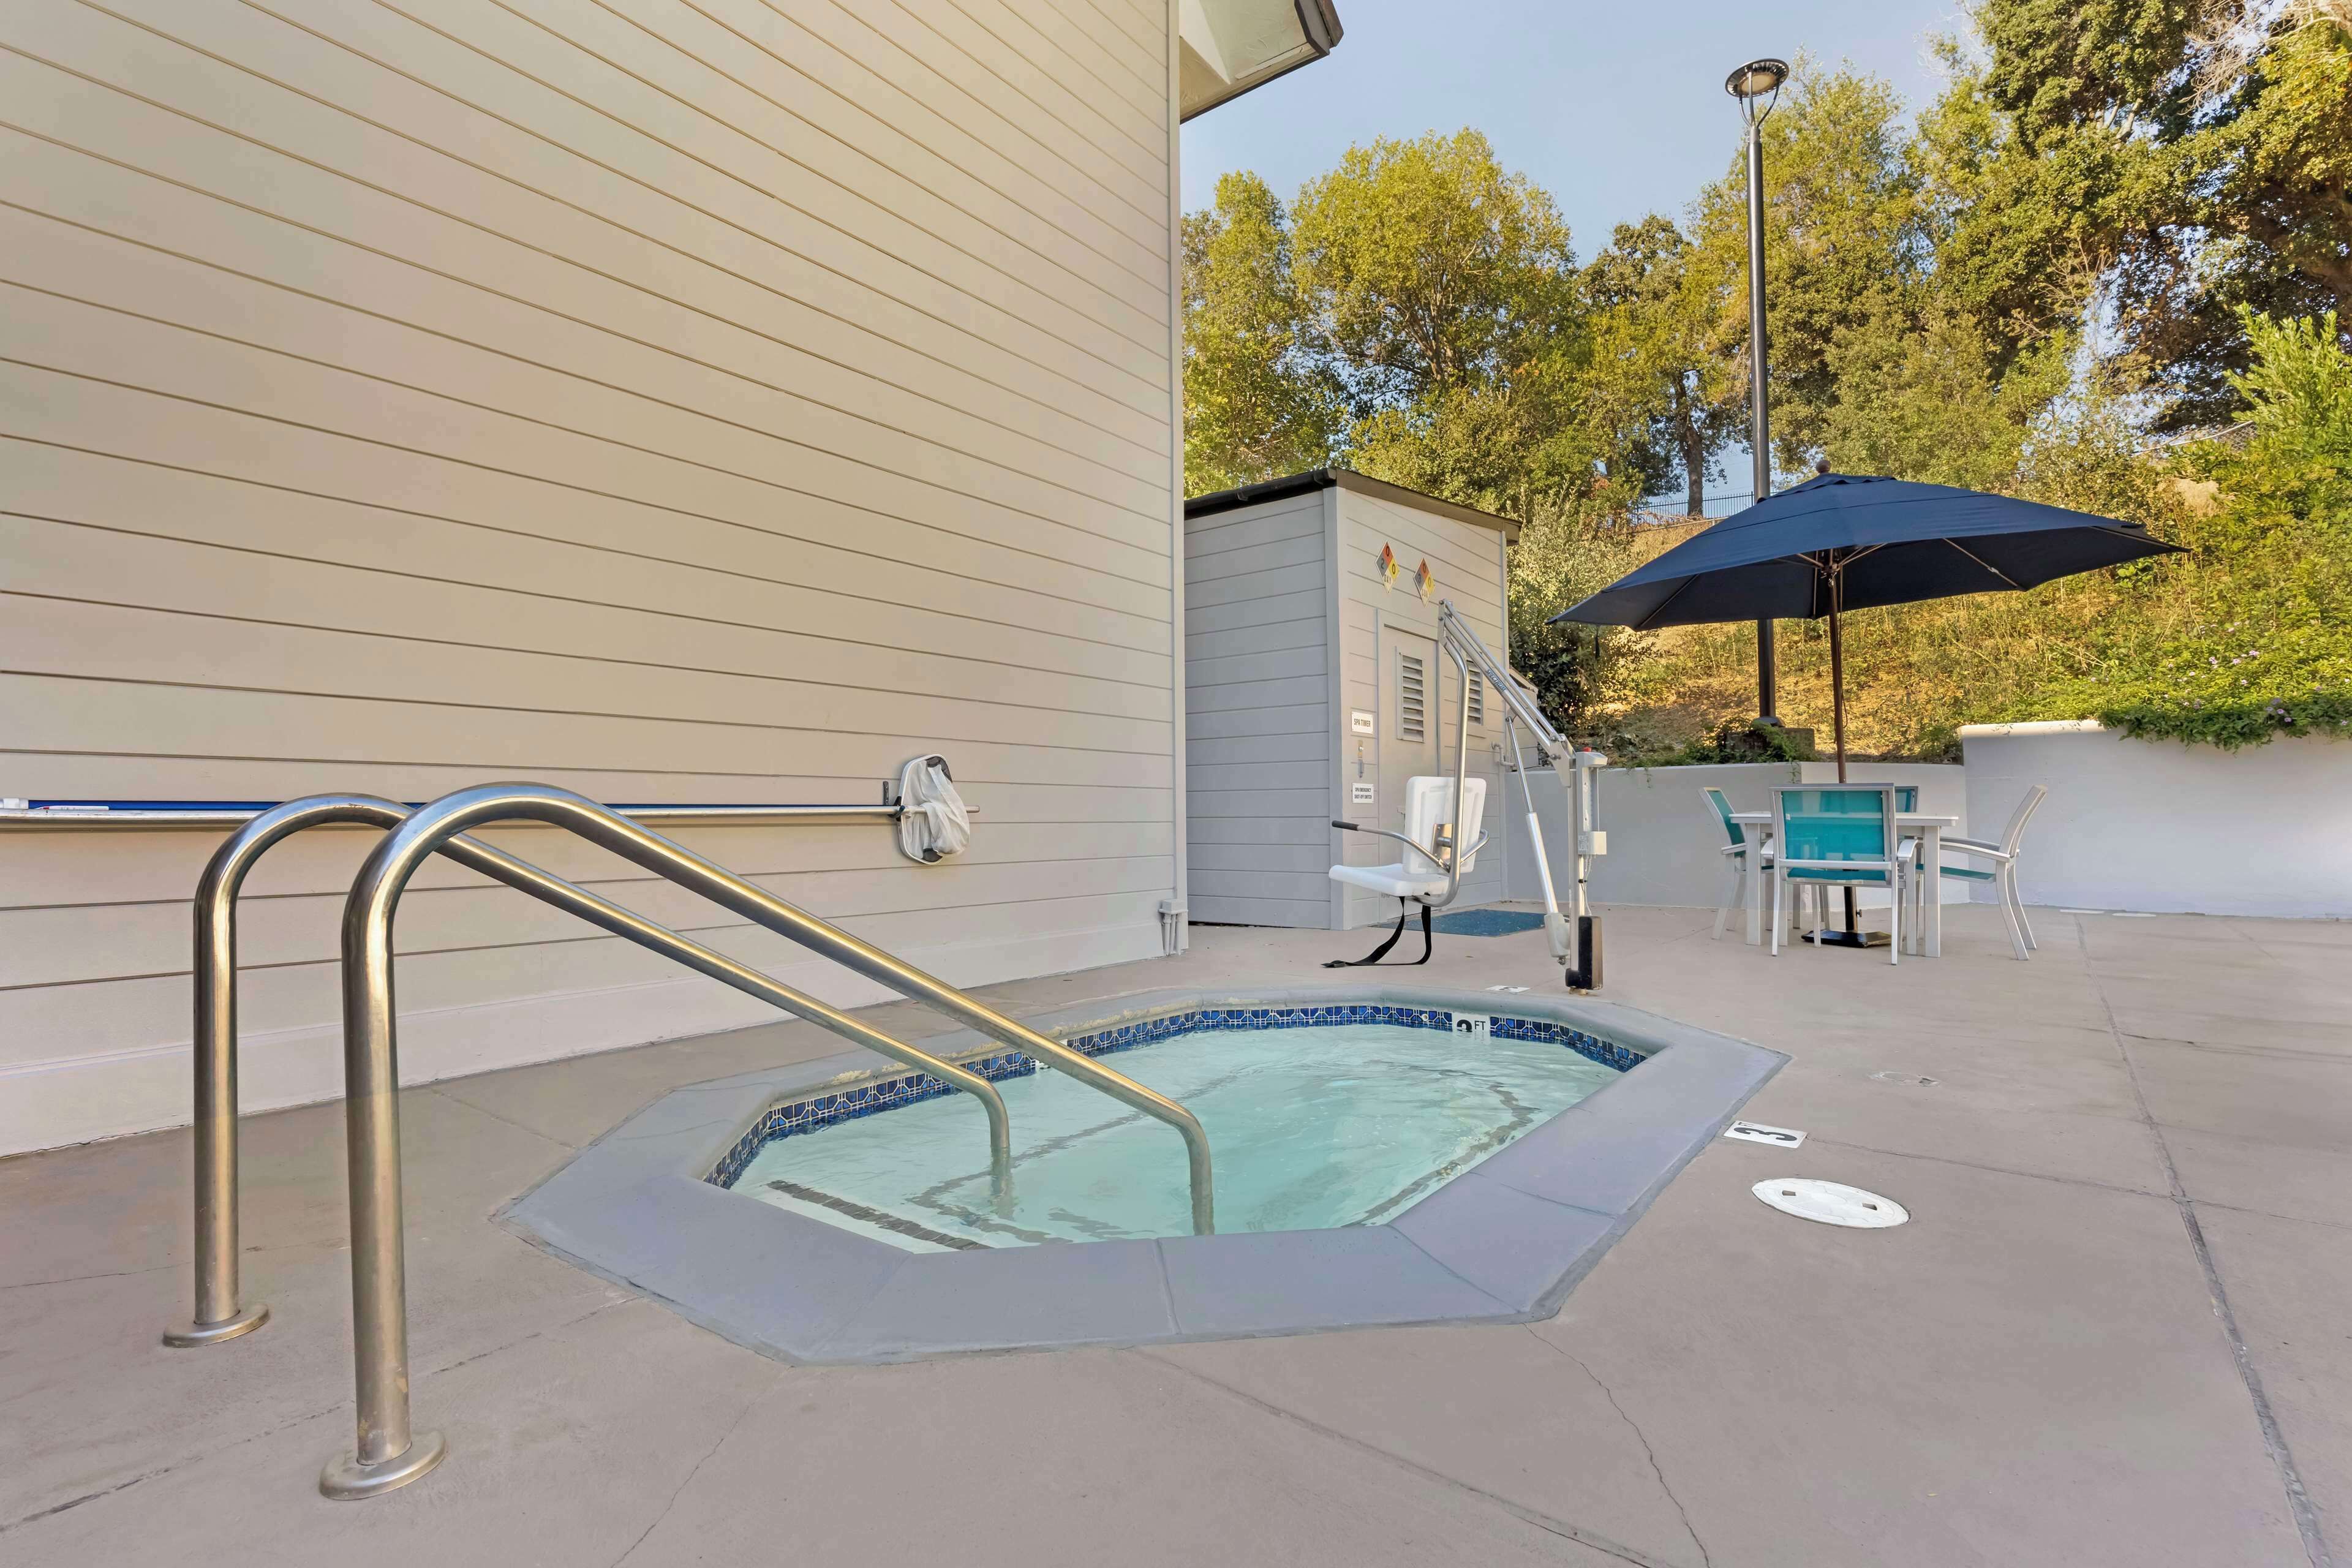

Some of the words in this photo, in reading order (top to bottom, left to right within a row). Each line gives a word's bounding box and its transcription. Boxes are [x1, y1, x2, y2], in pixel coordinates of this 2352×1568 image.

[1392, 563, 1396, 575] 0
[1485, 669, 1506, 692] SPECTRUM
[1474, 1020, 1486, 1030] FT
